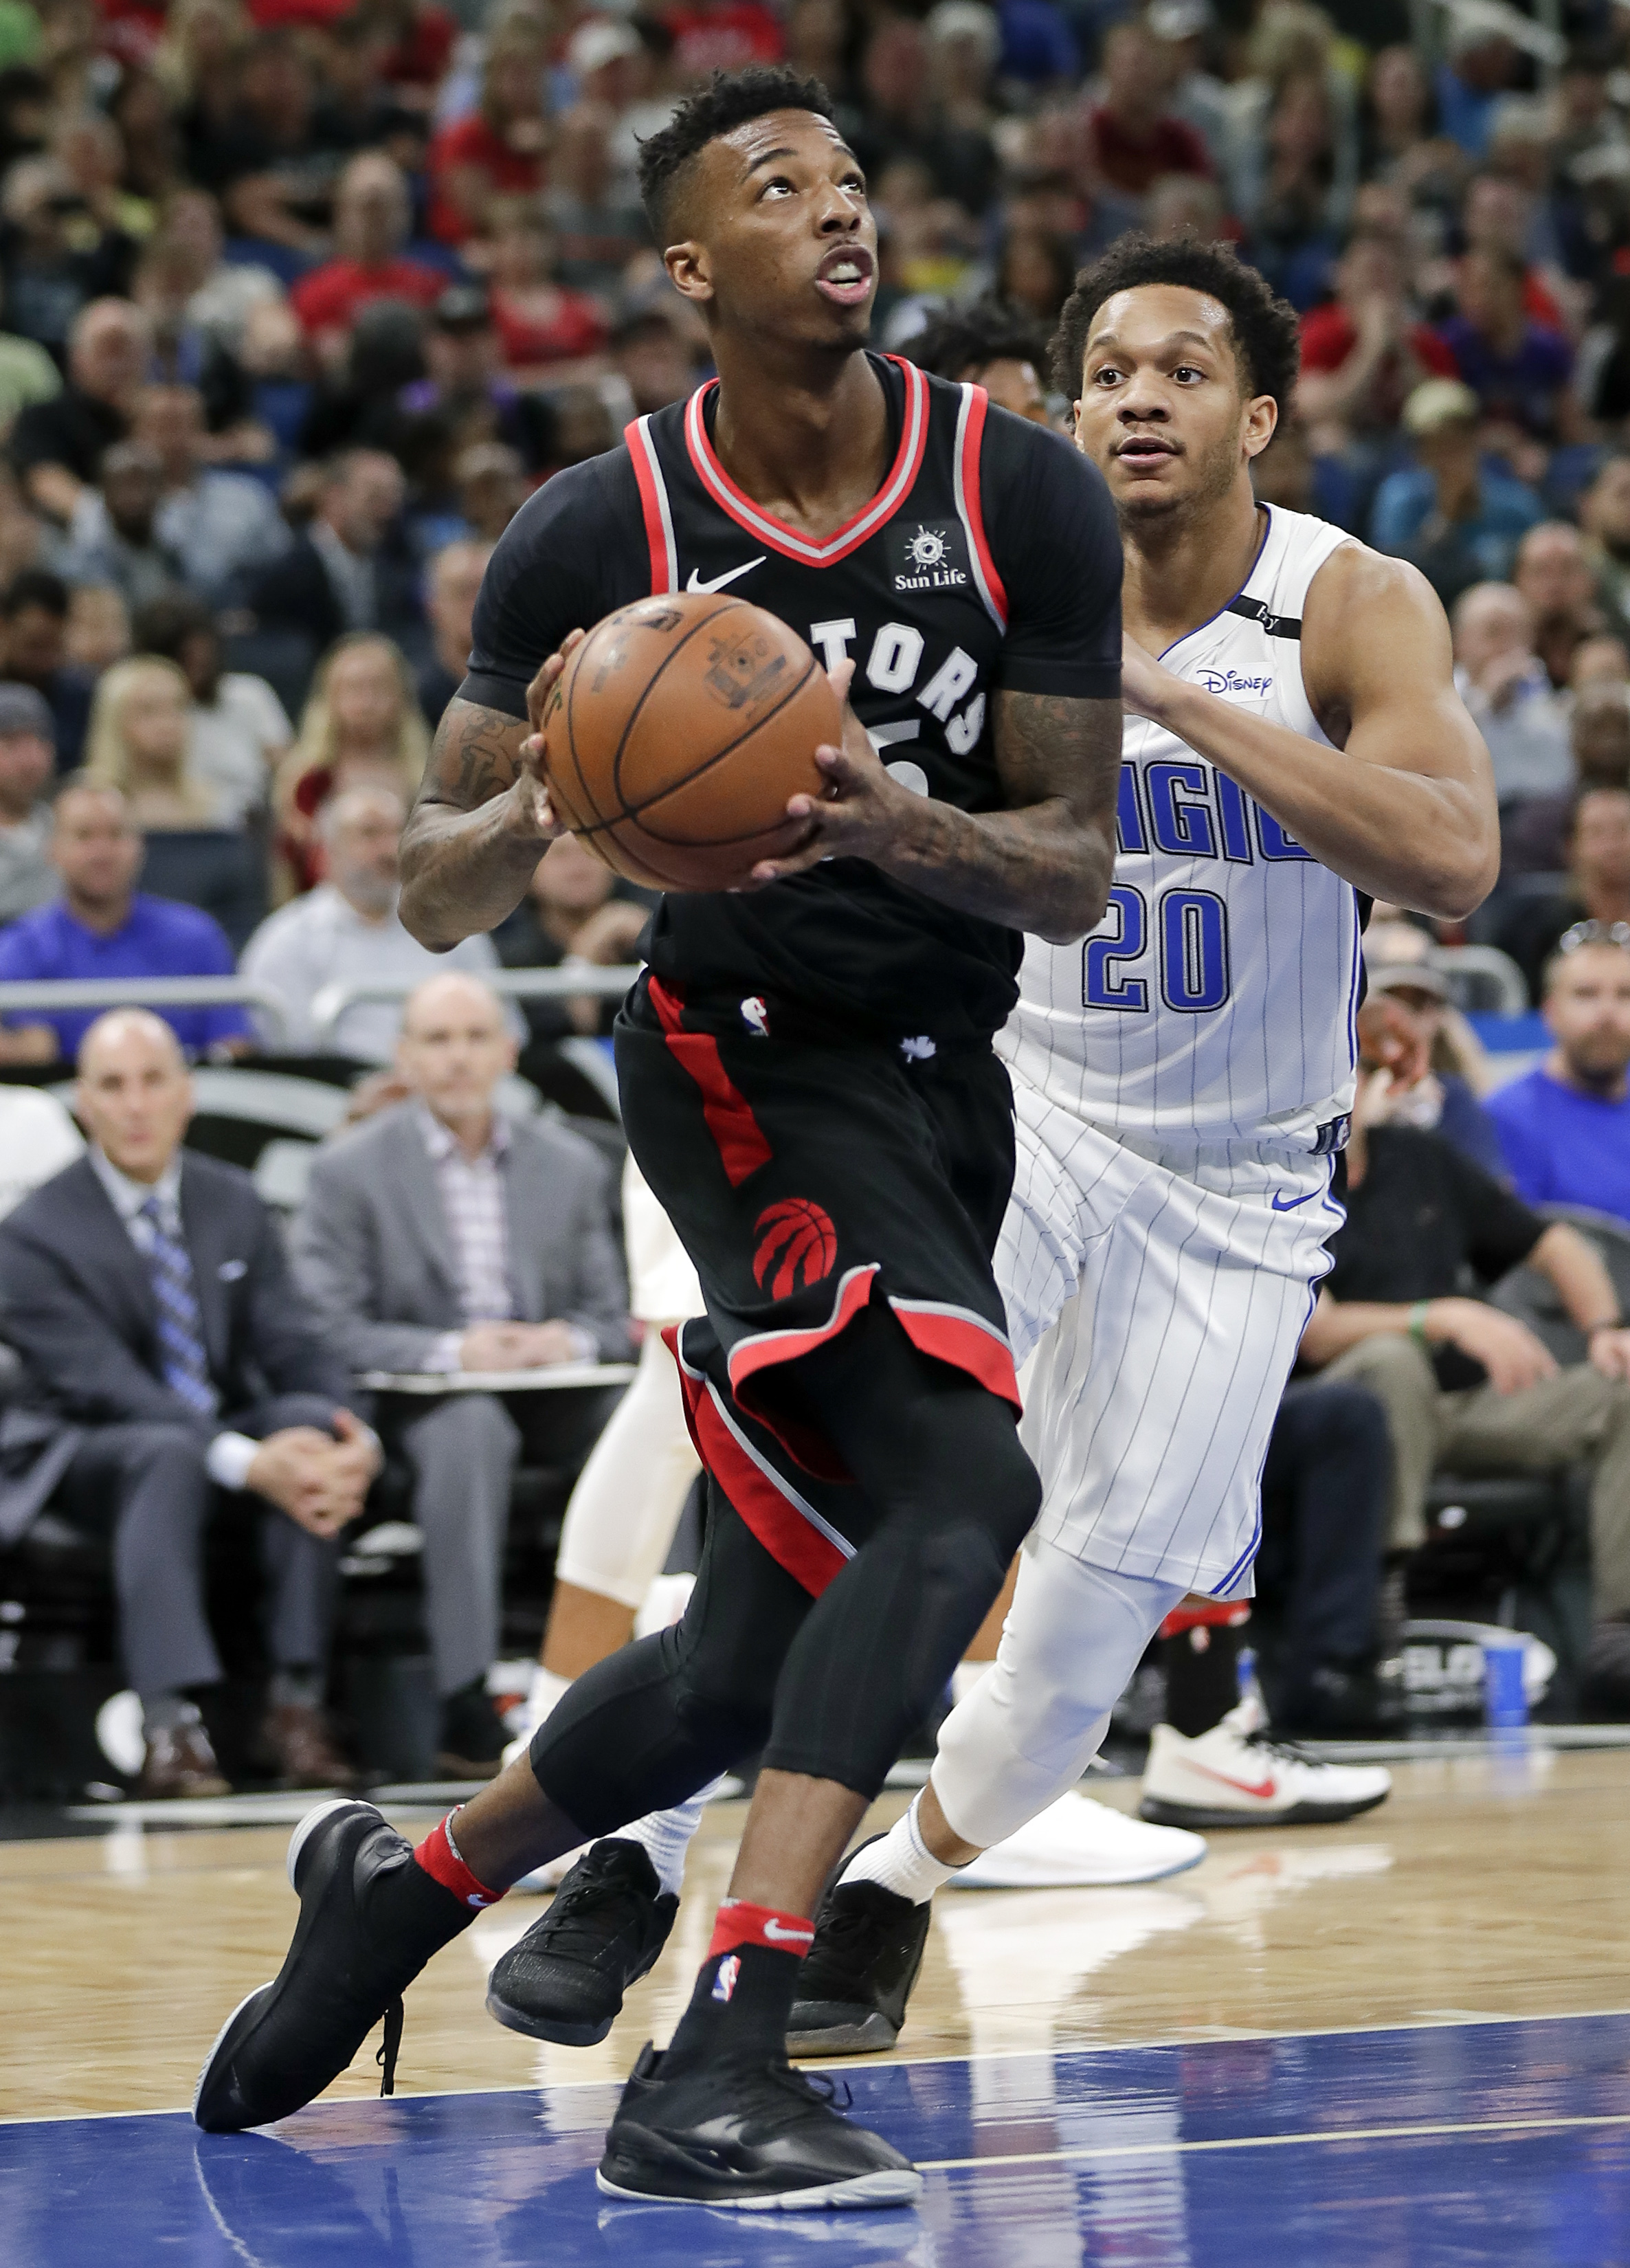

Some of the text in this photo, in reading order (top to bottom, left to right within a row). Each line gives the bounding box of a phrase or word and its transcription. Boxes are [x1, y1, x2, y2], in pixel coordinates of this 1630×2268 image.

[894, 568, 967, 591] Sun Life
[810, 617, 987, 756] TORS
[1082, 882, 1230, 1014] 20
